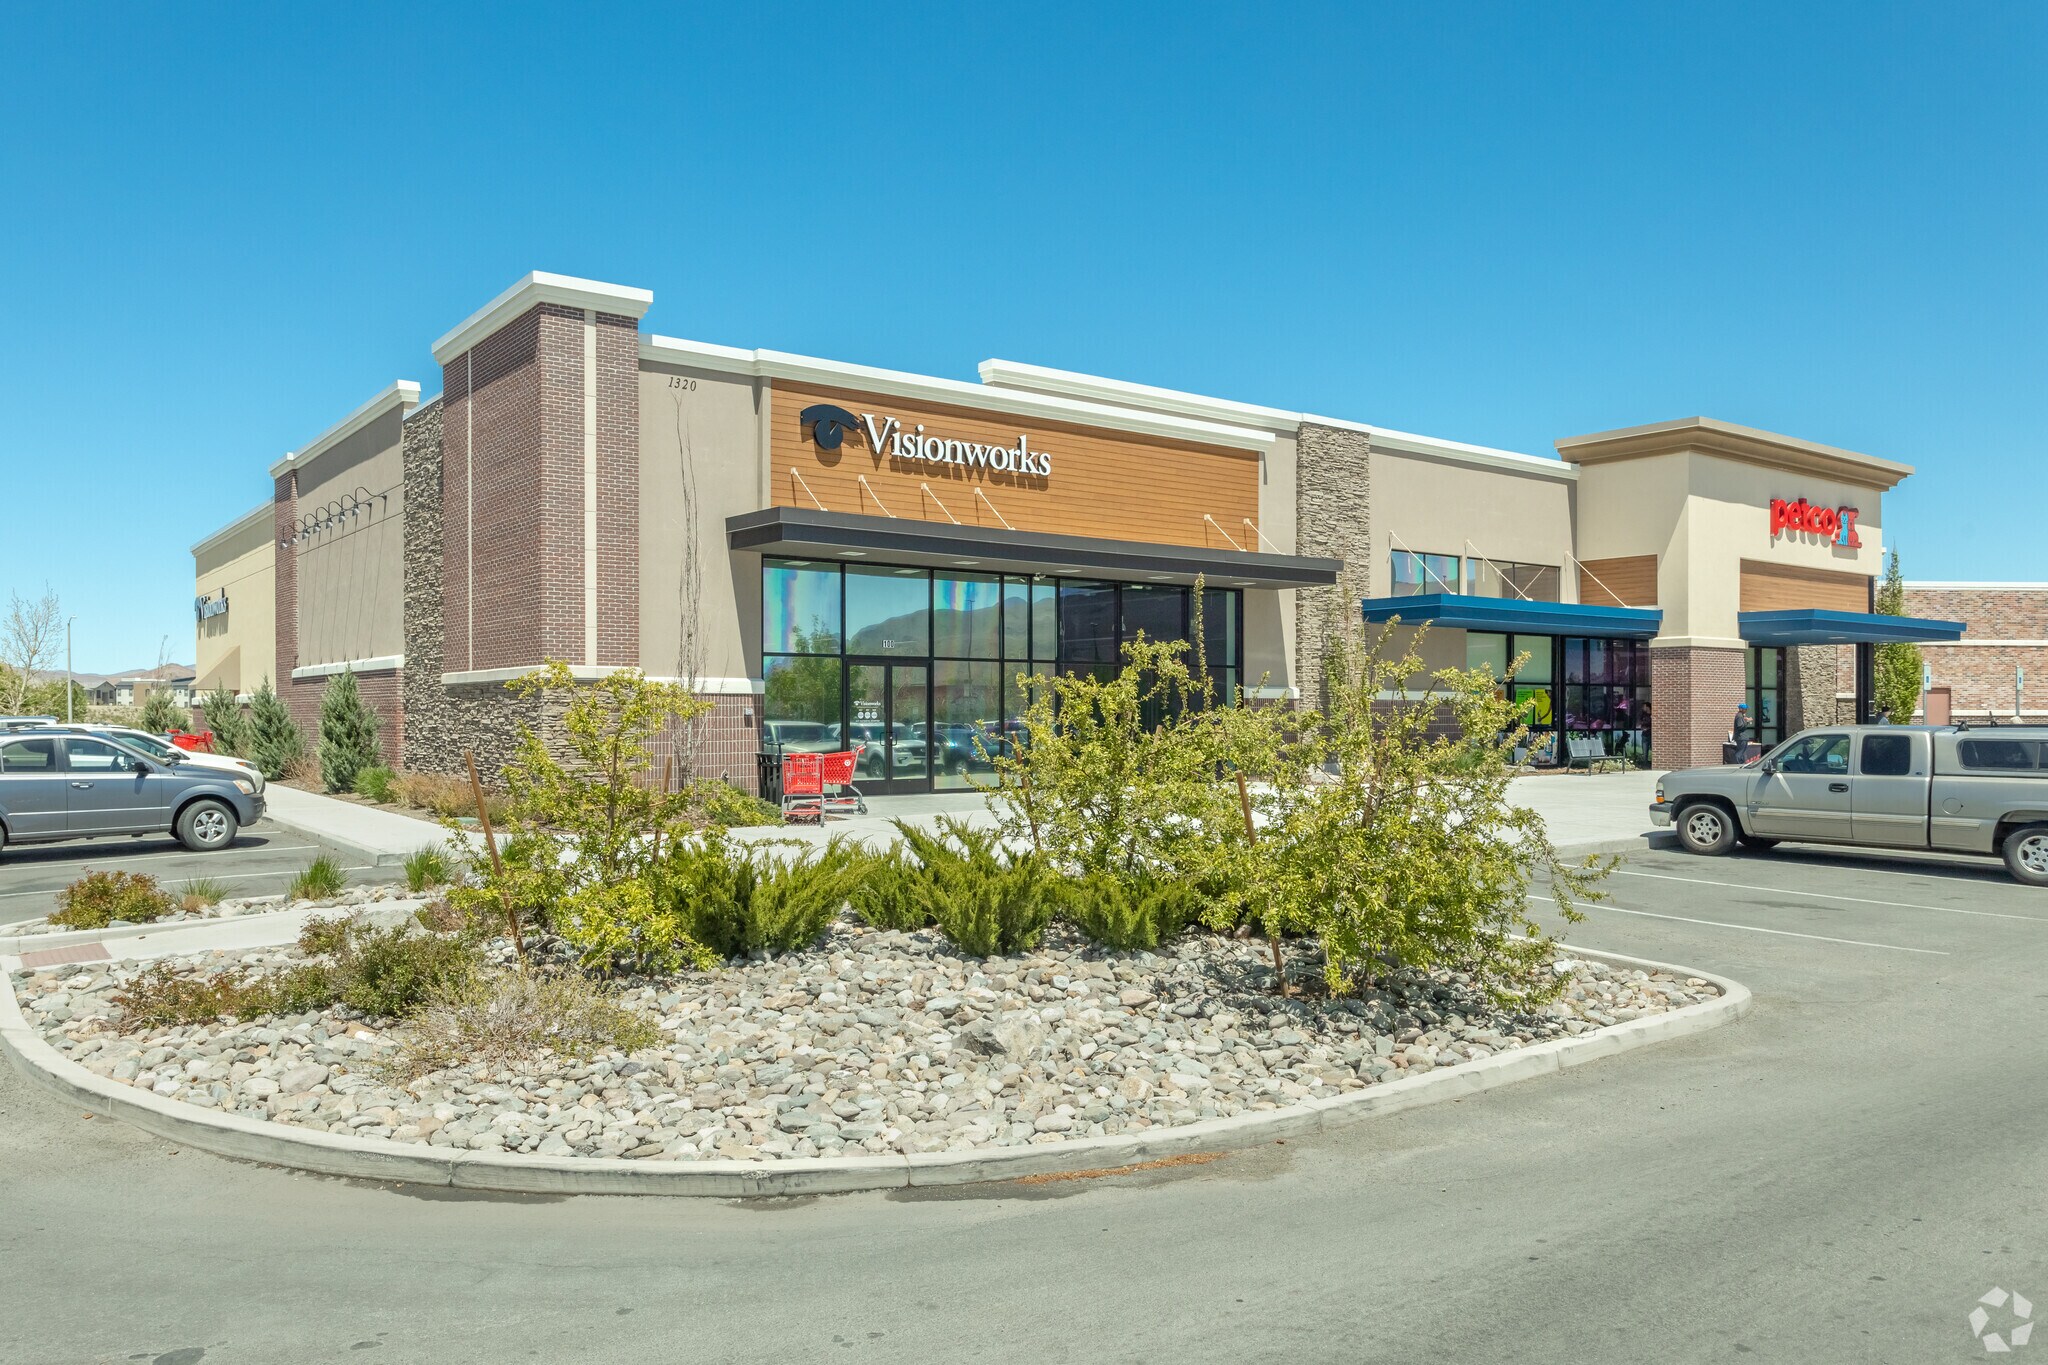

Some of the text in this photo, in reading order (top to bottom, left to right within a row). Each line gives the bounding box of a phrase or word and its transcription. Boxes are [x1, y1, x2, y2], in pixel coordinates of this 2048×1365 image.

[668, 376, 697, 392] 1320
[860, 412, 1051, 477] Visionworks
[1769, 498, 1837, 537] petco
